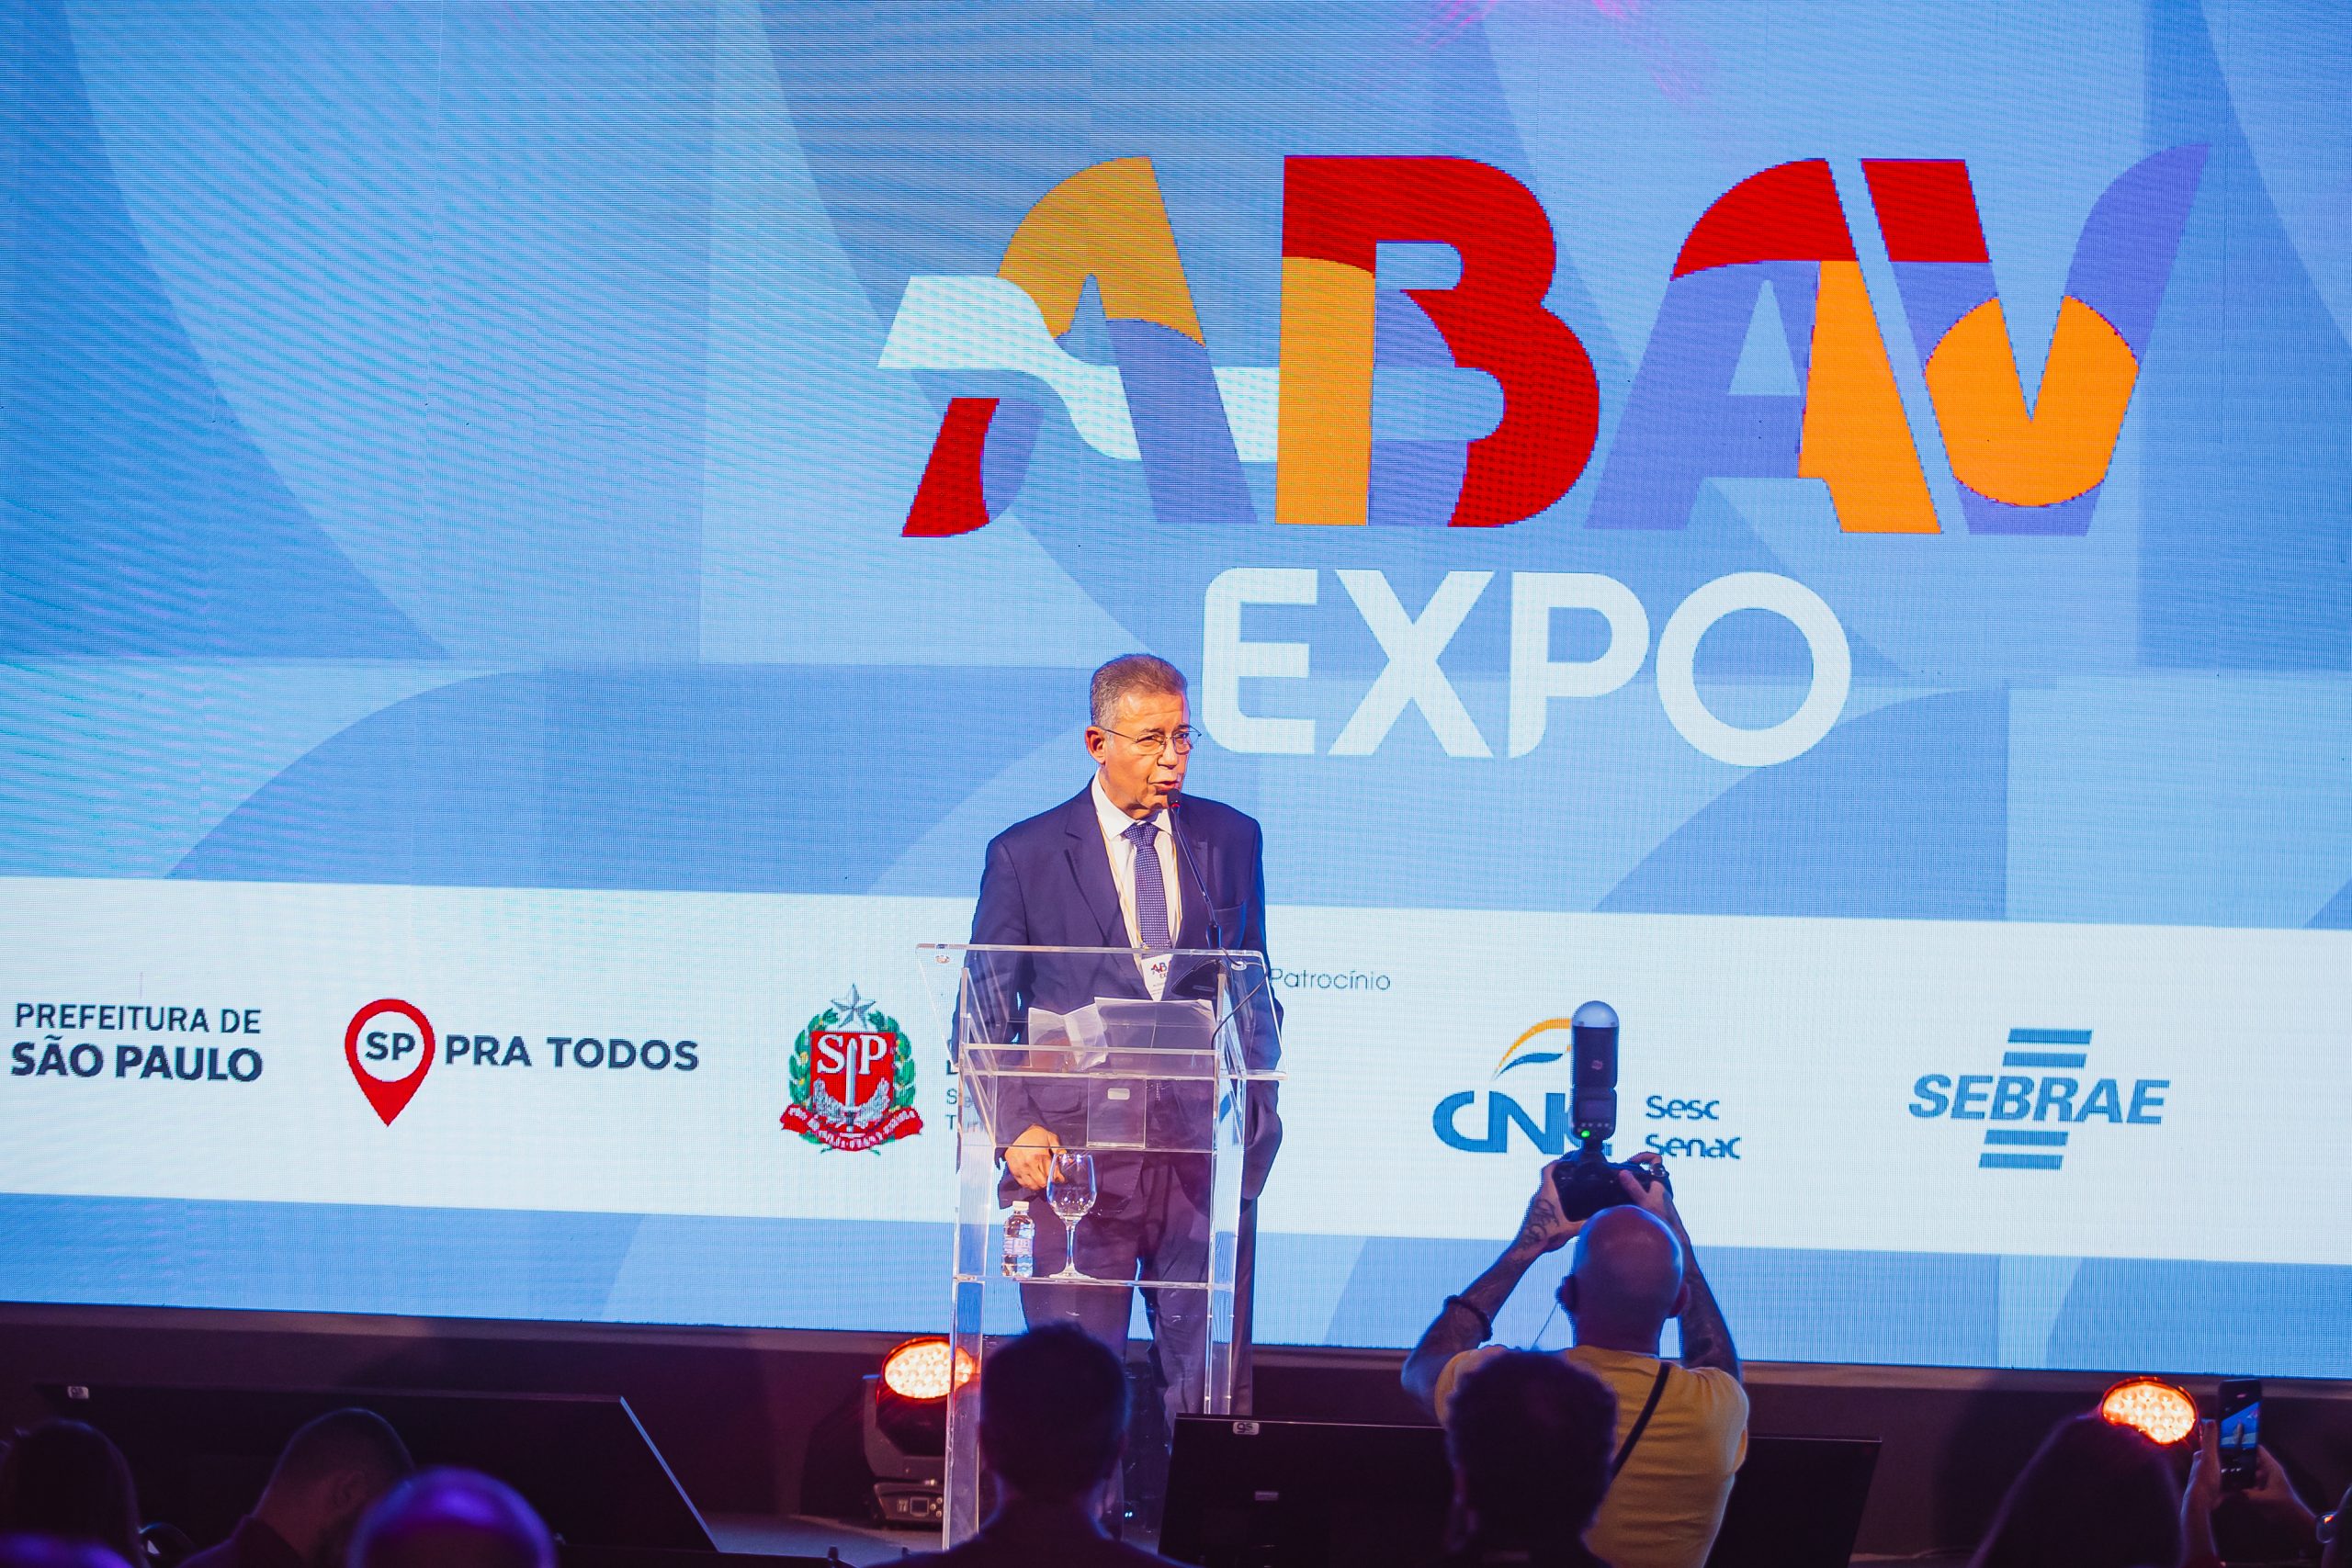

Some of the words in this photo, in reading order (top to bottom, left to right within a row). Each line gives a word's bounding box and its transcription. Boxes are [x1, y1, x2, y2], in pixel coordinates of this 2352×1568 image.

[877, 143, 2207, 537] ABAV
[1202, 567, 1850, 766] EXPO
[1271, 968, 1390, 990] Patrocínio
[16, 1002, 209, 1033] PREFEITURA
[220, 1009, 262, 1034] DE
[11, 1034, 104, 1077] SÃO
[115, 1044, 263, 1082] PAULO
[365, 1031, 415, 1061] SP
[445, 1034, 533, 1067] PRA
[547, 1037, 699, 1071] TODOS
[1645, 1095, 1720, 1121] Sesc
[1908, 1074, 2170, 1125] SEBRAE
[1432, 1090, 1612, 1156] CN
[1645, 1134, 1741, 1159] Senac
